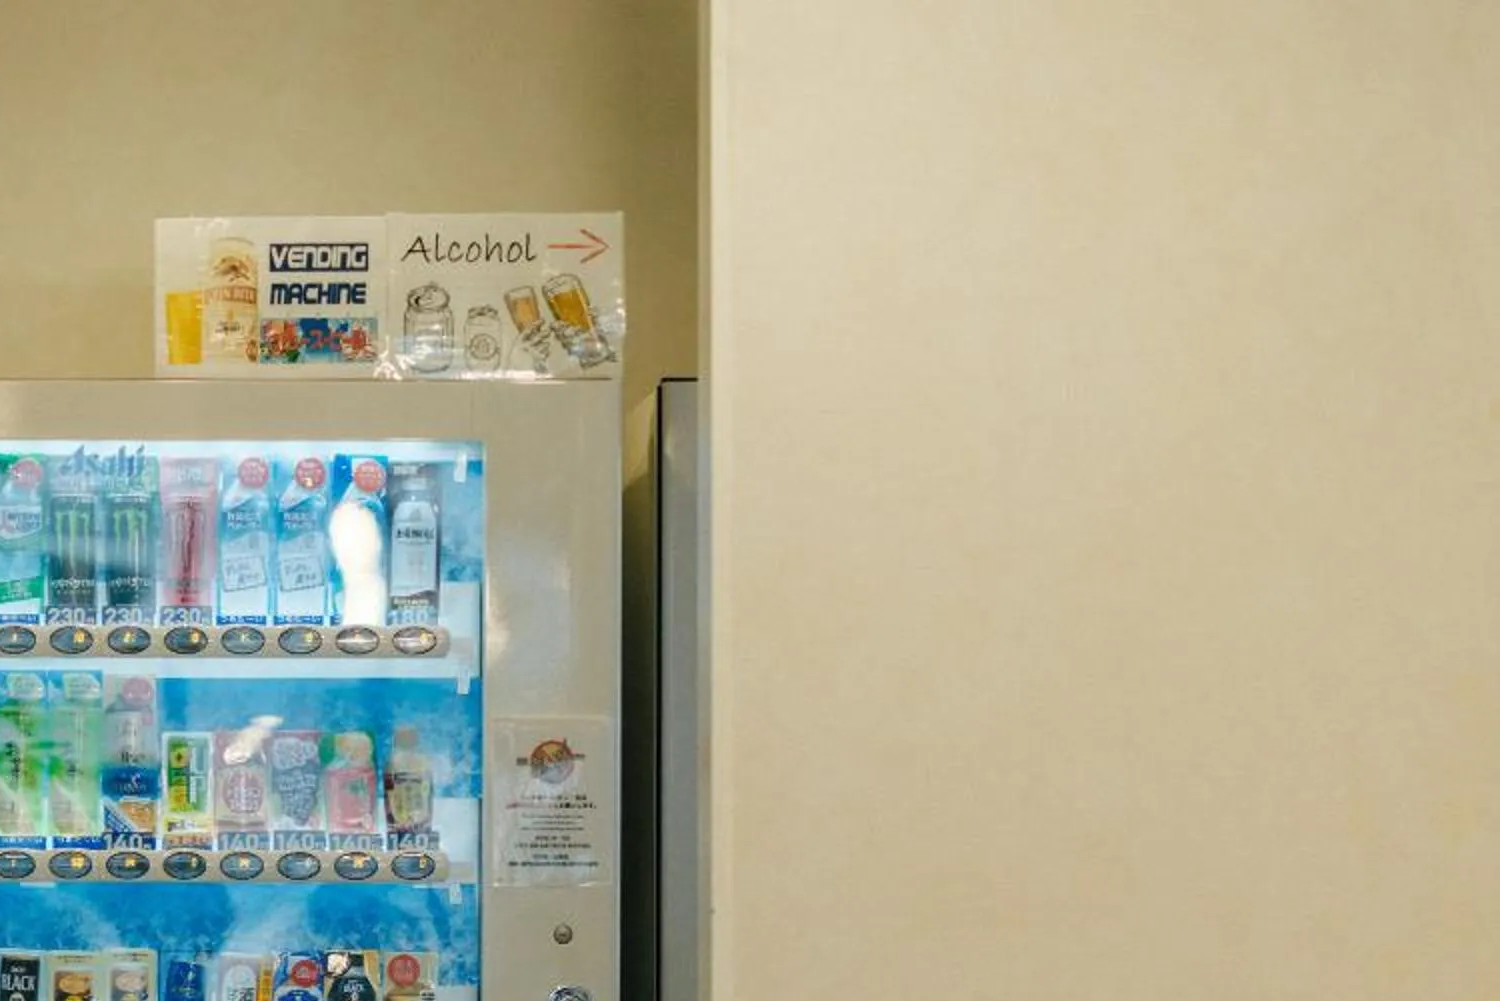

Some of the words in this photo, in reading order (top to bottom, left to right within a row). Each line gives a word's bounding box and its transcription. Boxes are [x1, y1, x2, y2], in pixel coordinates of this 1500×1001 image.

[401, 233, 536, 263] Alcohol
[271, 245, 367, 270] VENDING
[270, 283, 366, 304] MACHINE
[48, 607, 86, 625] 230
[105, 607, 143, 625] 230
[164, 607, 201, 625] 230
[102, 833, 142, 850] 140
[275, 832, 316, 850] 140
[1, 973, 36, 990] BLACK
